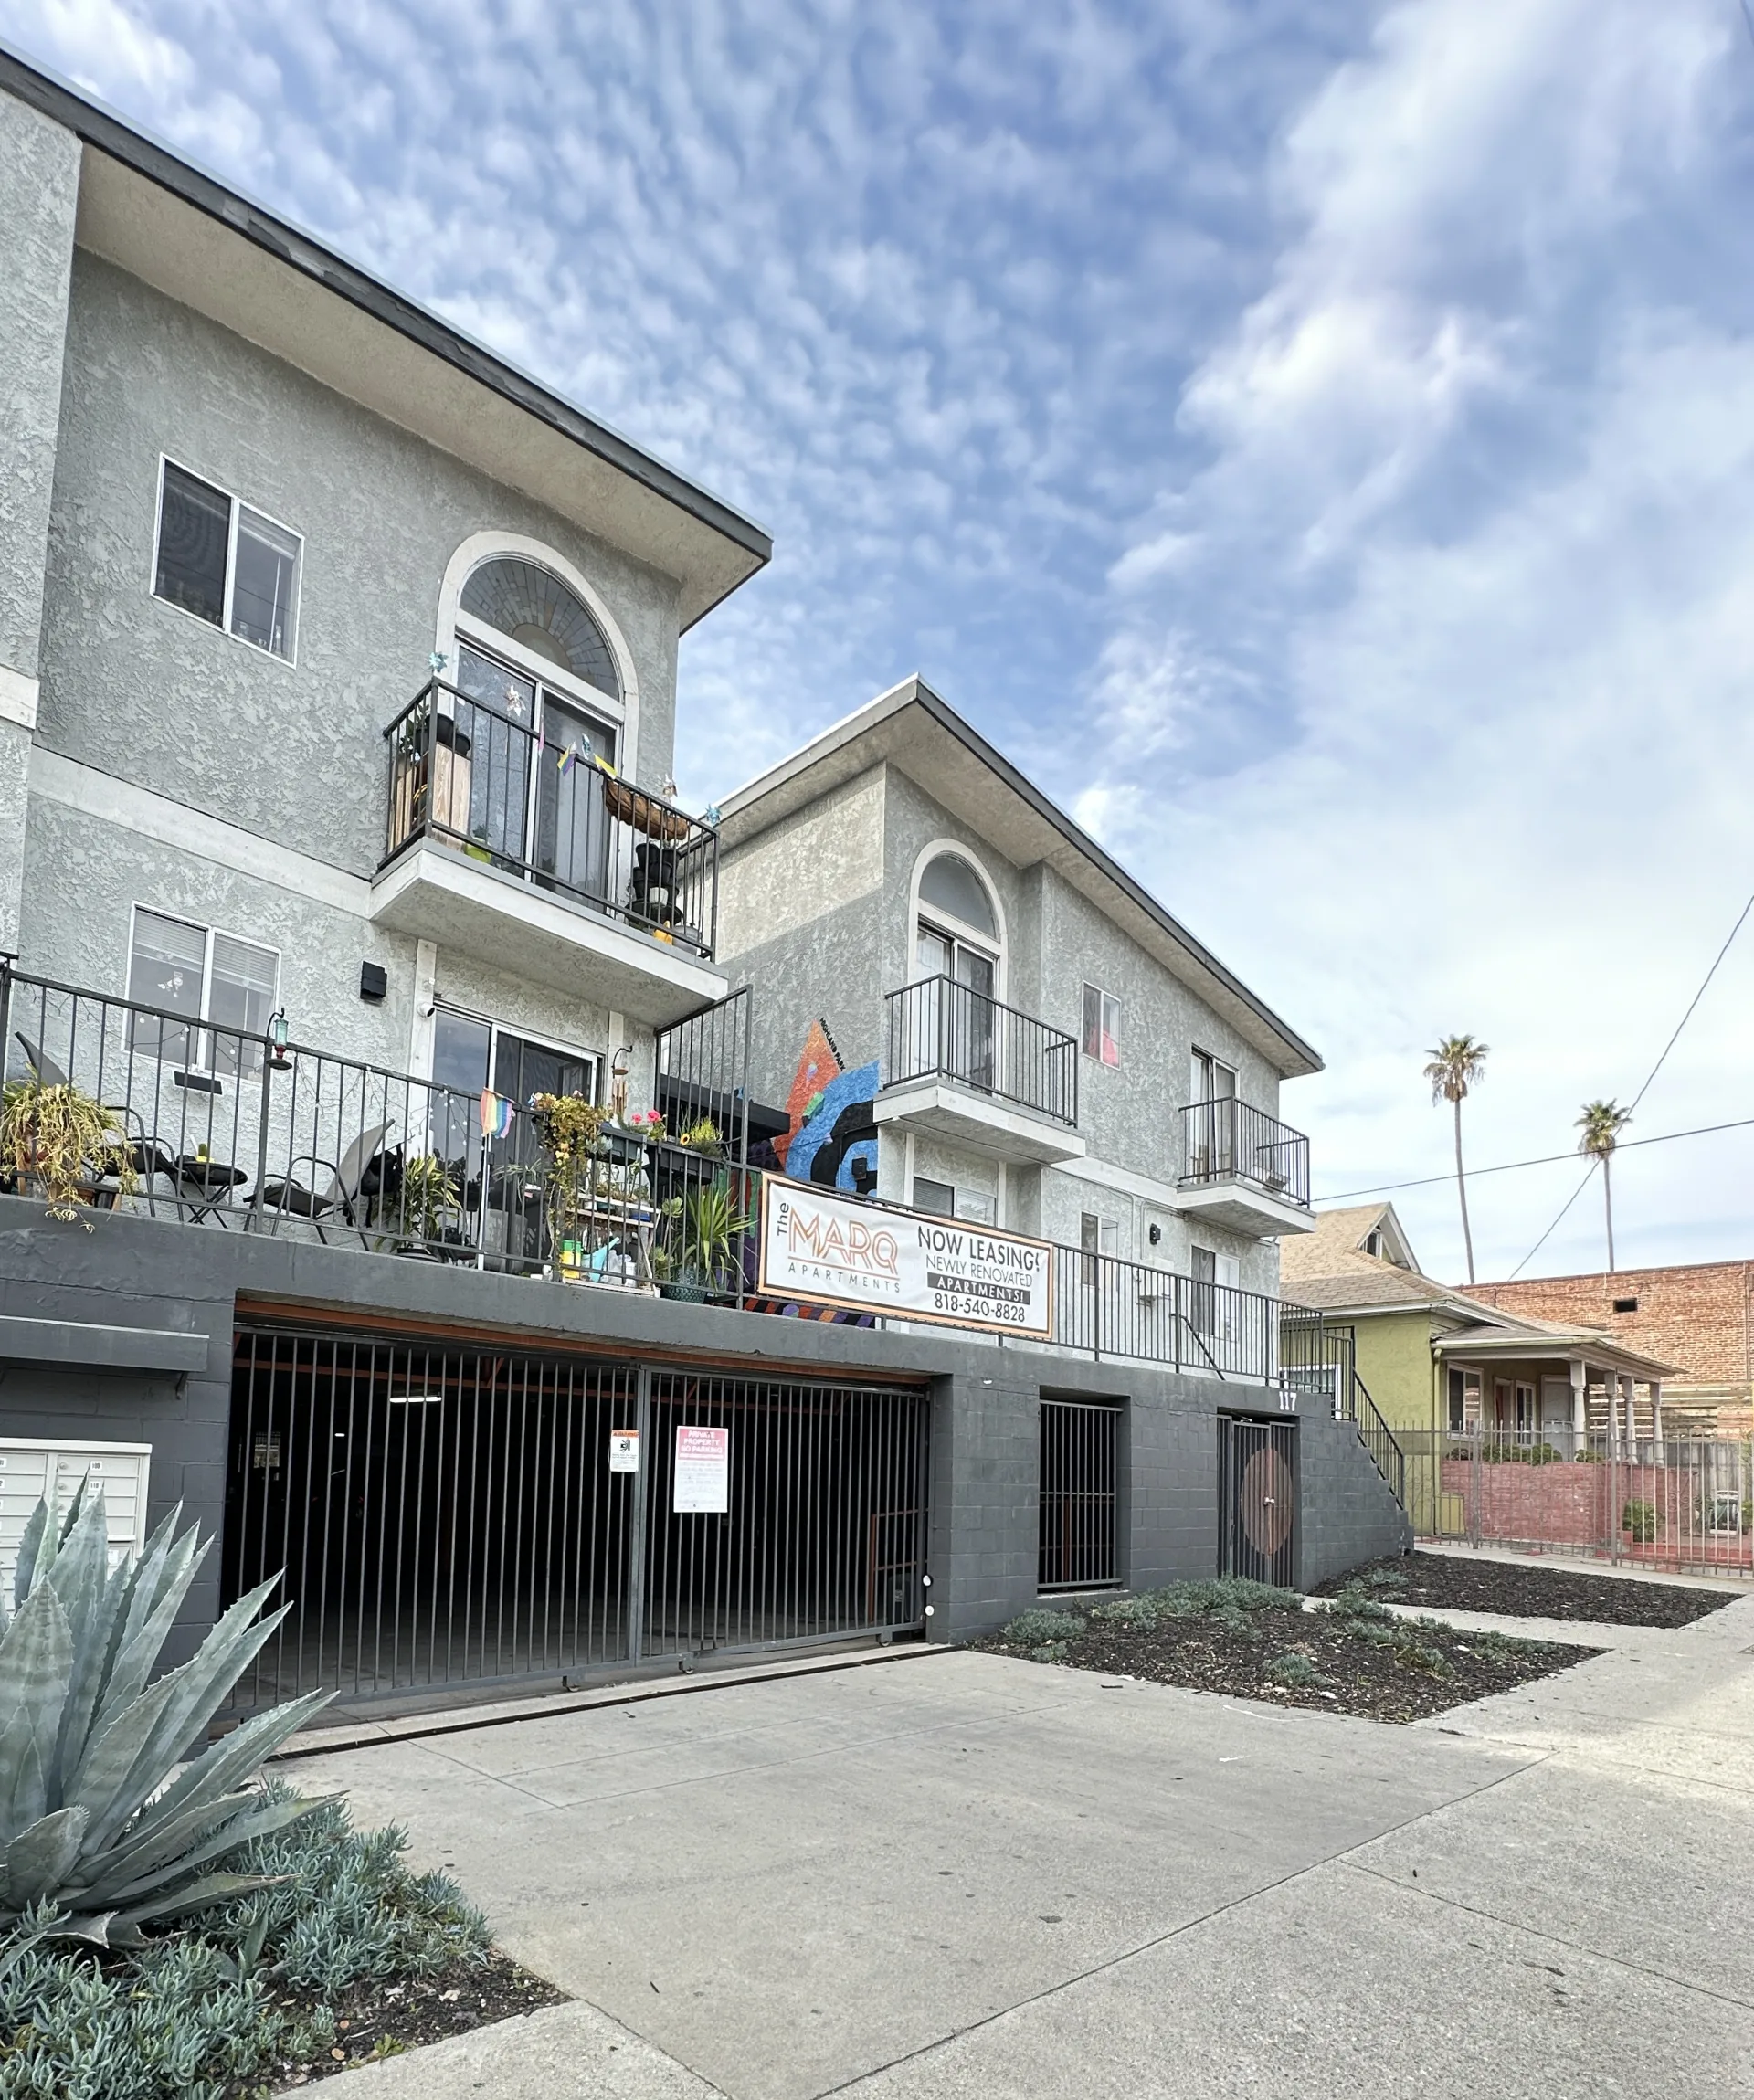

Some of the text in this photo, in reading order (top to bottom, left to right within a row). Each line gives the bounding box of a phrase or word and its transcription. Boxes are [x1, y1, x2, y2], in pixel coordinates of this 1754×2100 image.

[834, 1051, 846, 1071] PARK
[777, 1202, 789, 1236] The
[788, 1206, 898, 1275] MARQ
[917, 1225, 1040, 1272] NOW LEASING!
[788, 1262, 900, 1293] APARTMENTS
[925, 1254, 1032, 1287] NEWLY RENOVATED
[936, 1276, 1024, 1303] APARTMENTS!
[935, 1293, 1025, 1323] 818-540-8828
[1278, 1390, 1297, 1412] 117
[683, 1438, 721, 1446] PROPERTY
[688, 1430, 715, 1439] PRIVATE
